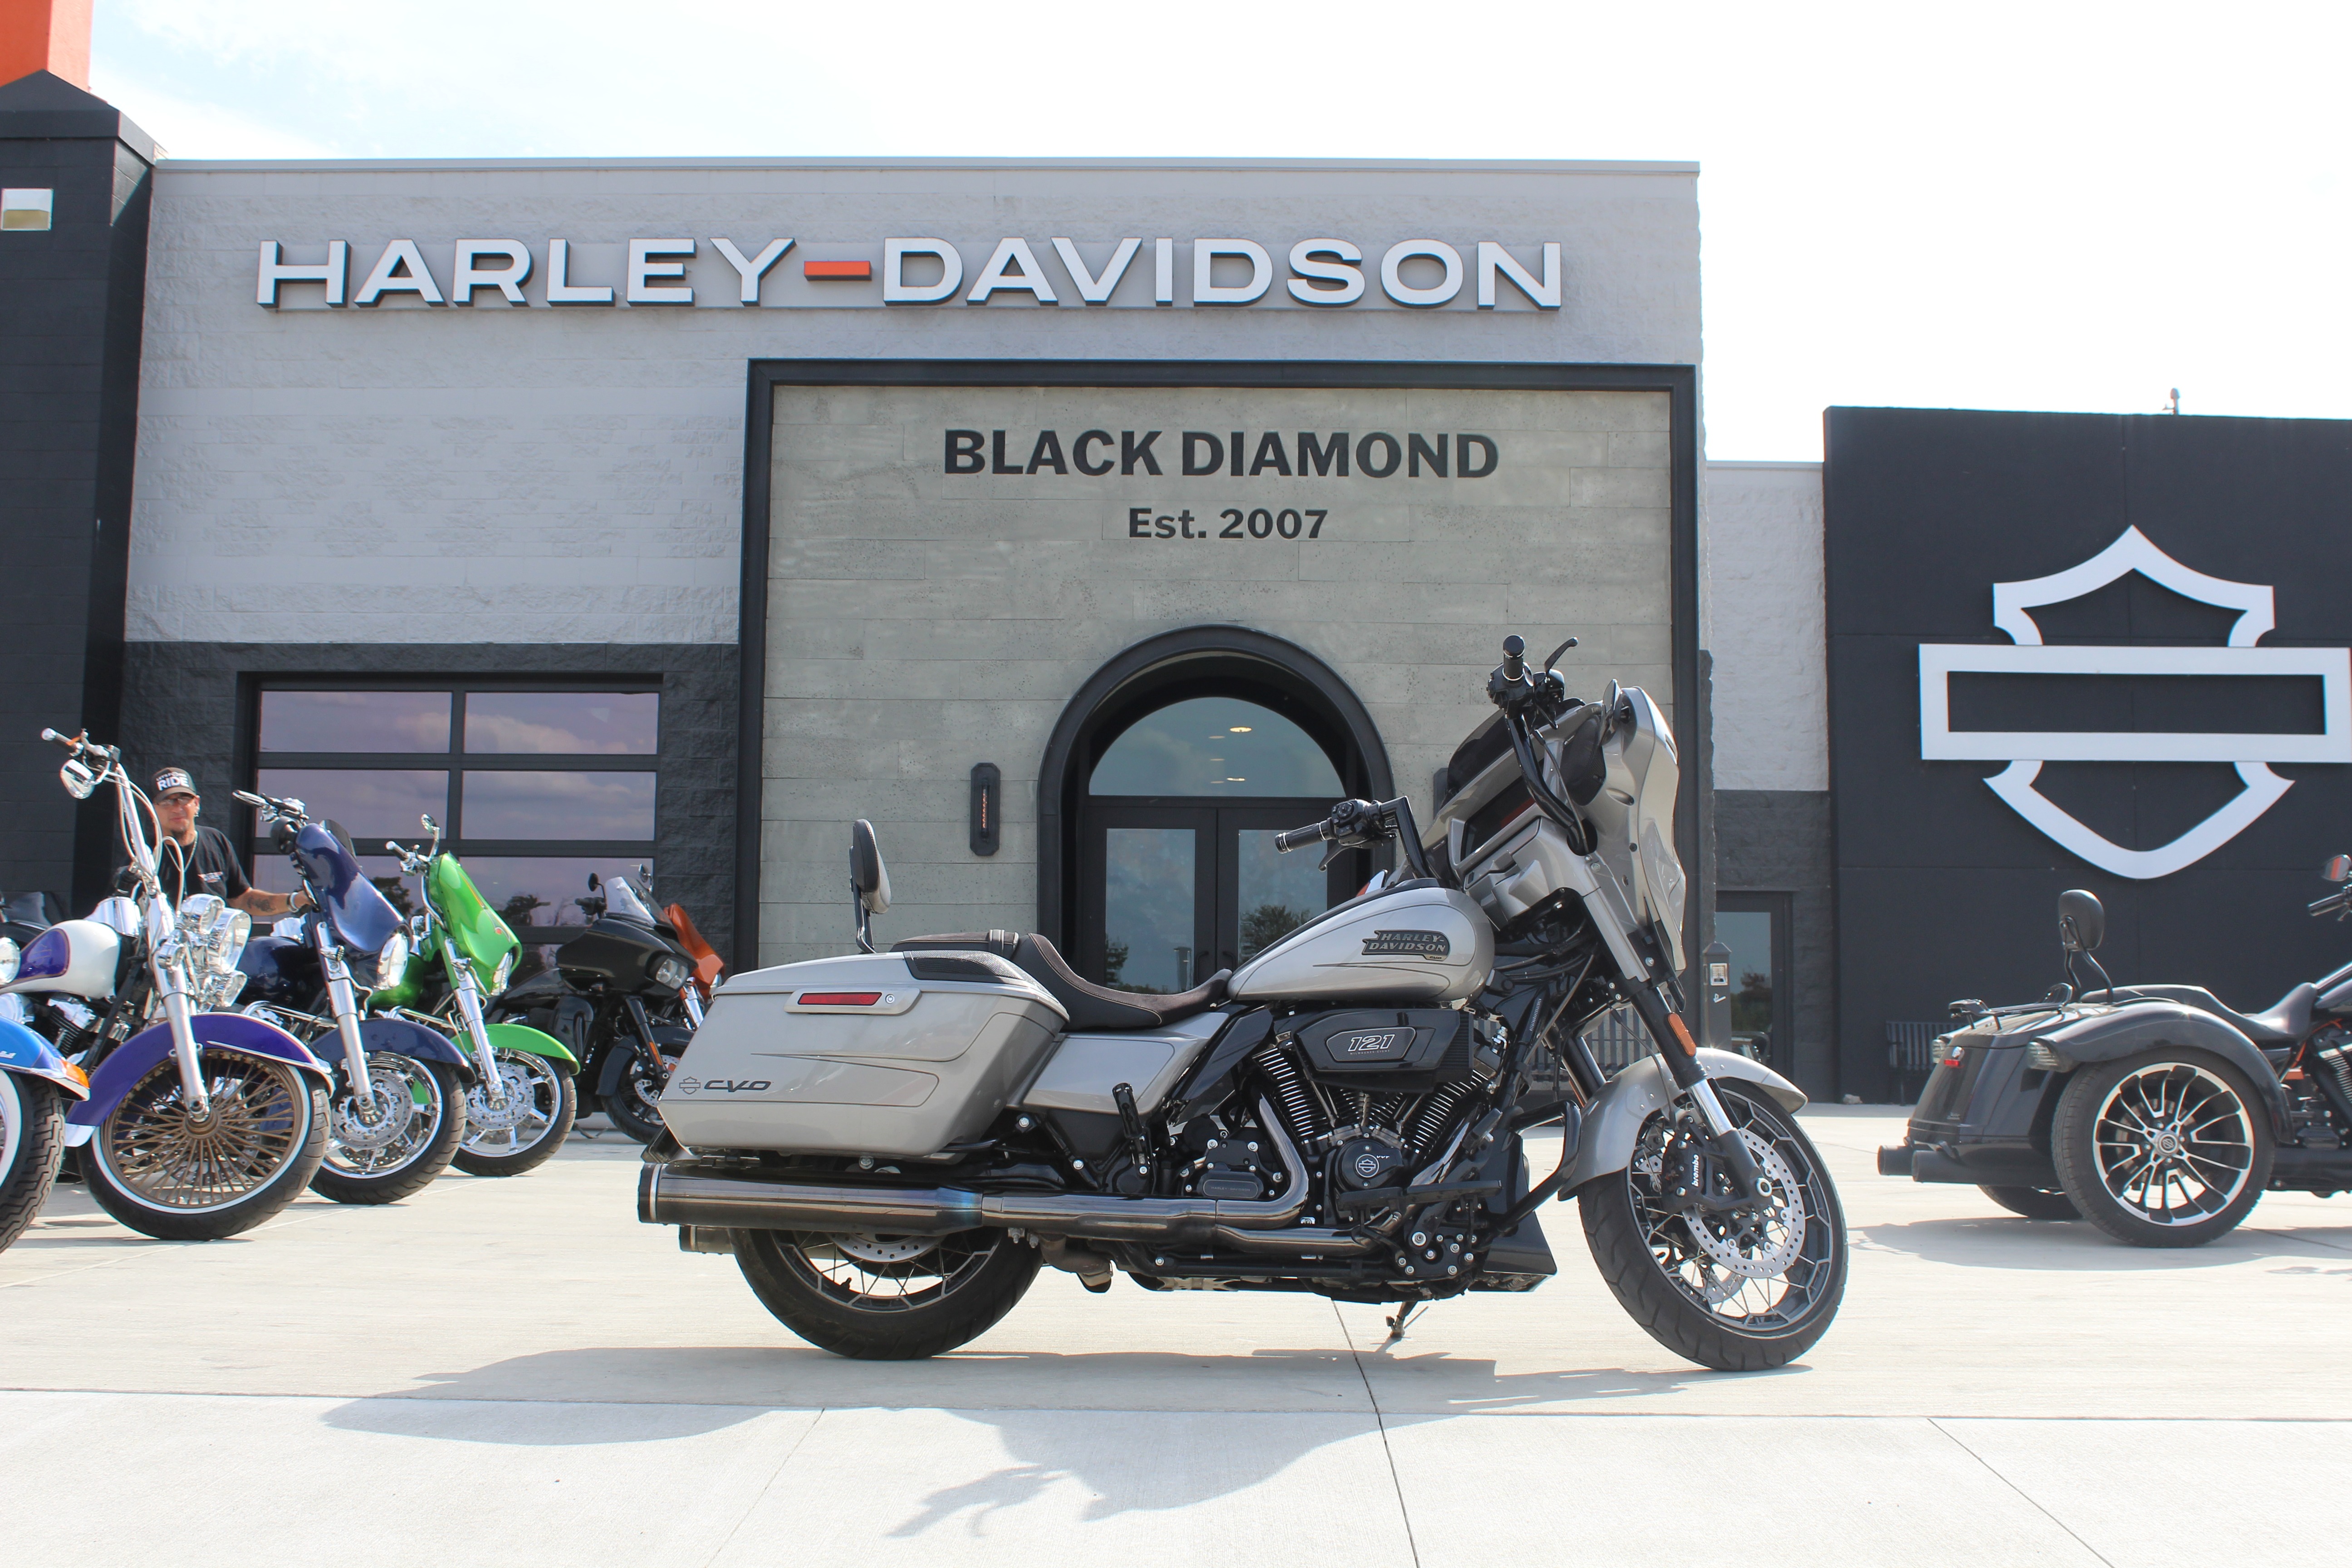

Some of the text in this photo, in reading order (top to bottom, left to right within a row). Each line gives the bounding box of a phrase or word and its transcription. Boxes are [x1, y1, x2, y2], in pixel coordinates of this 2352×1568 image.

[945, 430, 1498, 478] BLACK DIAMOND
[1129, 508, 1328, 539] Est. 2007
[157, 776, 189, 791] RIDE
[1381, 933, 1445, 942] HARLEY-
[1369, 942, 1446, 952] DAVIDSON
[1348, 1034, 1395, 1052] 121
[704, 1080, 771, 1093] CVO
